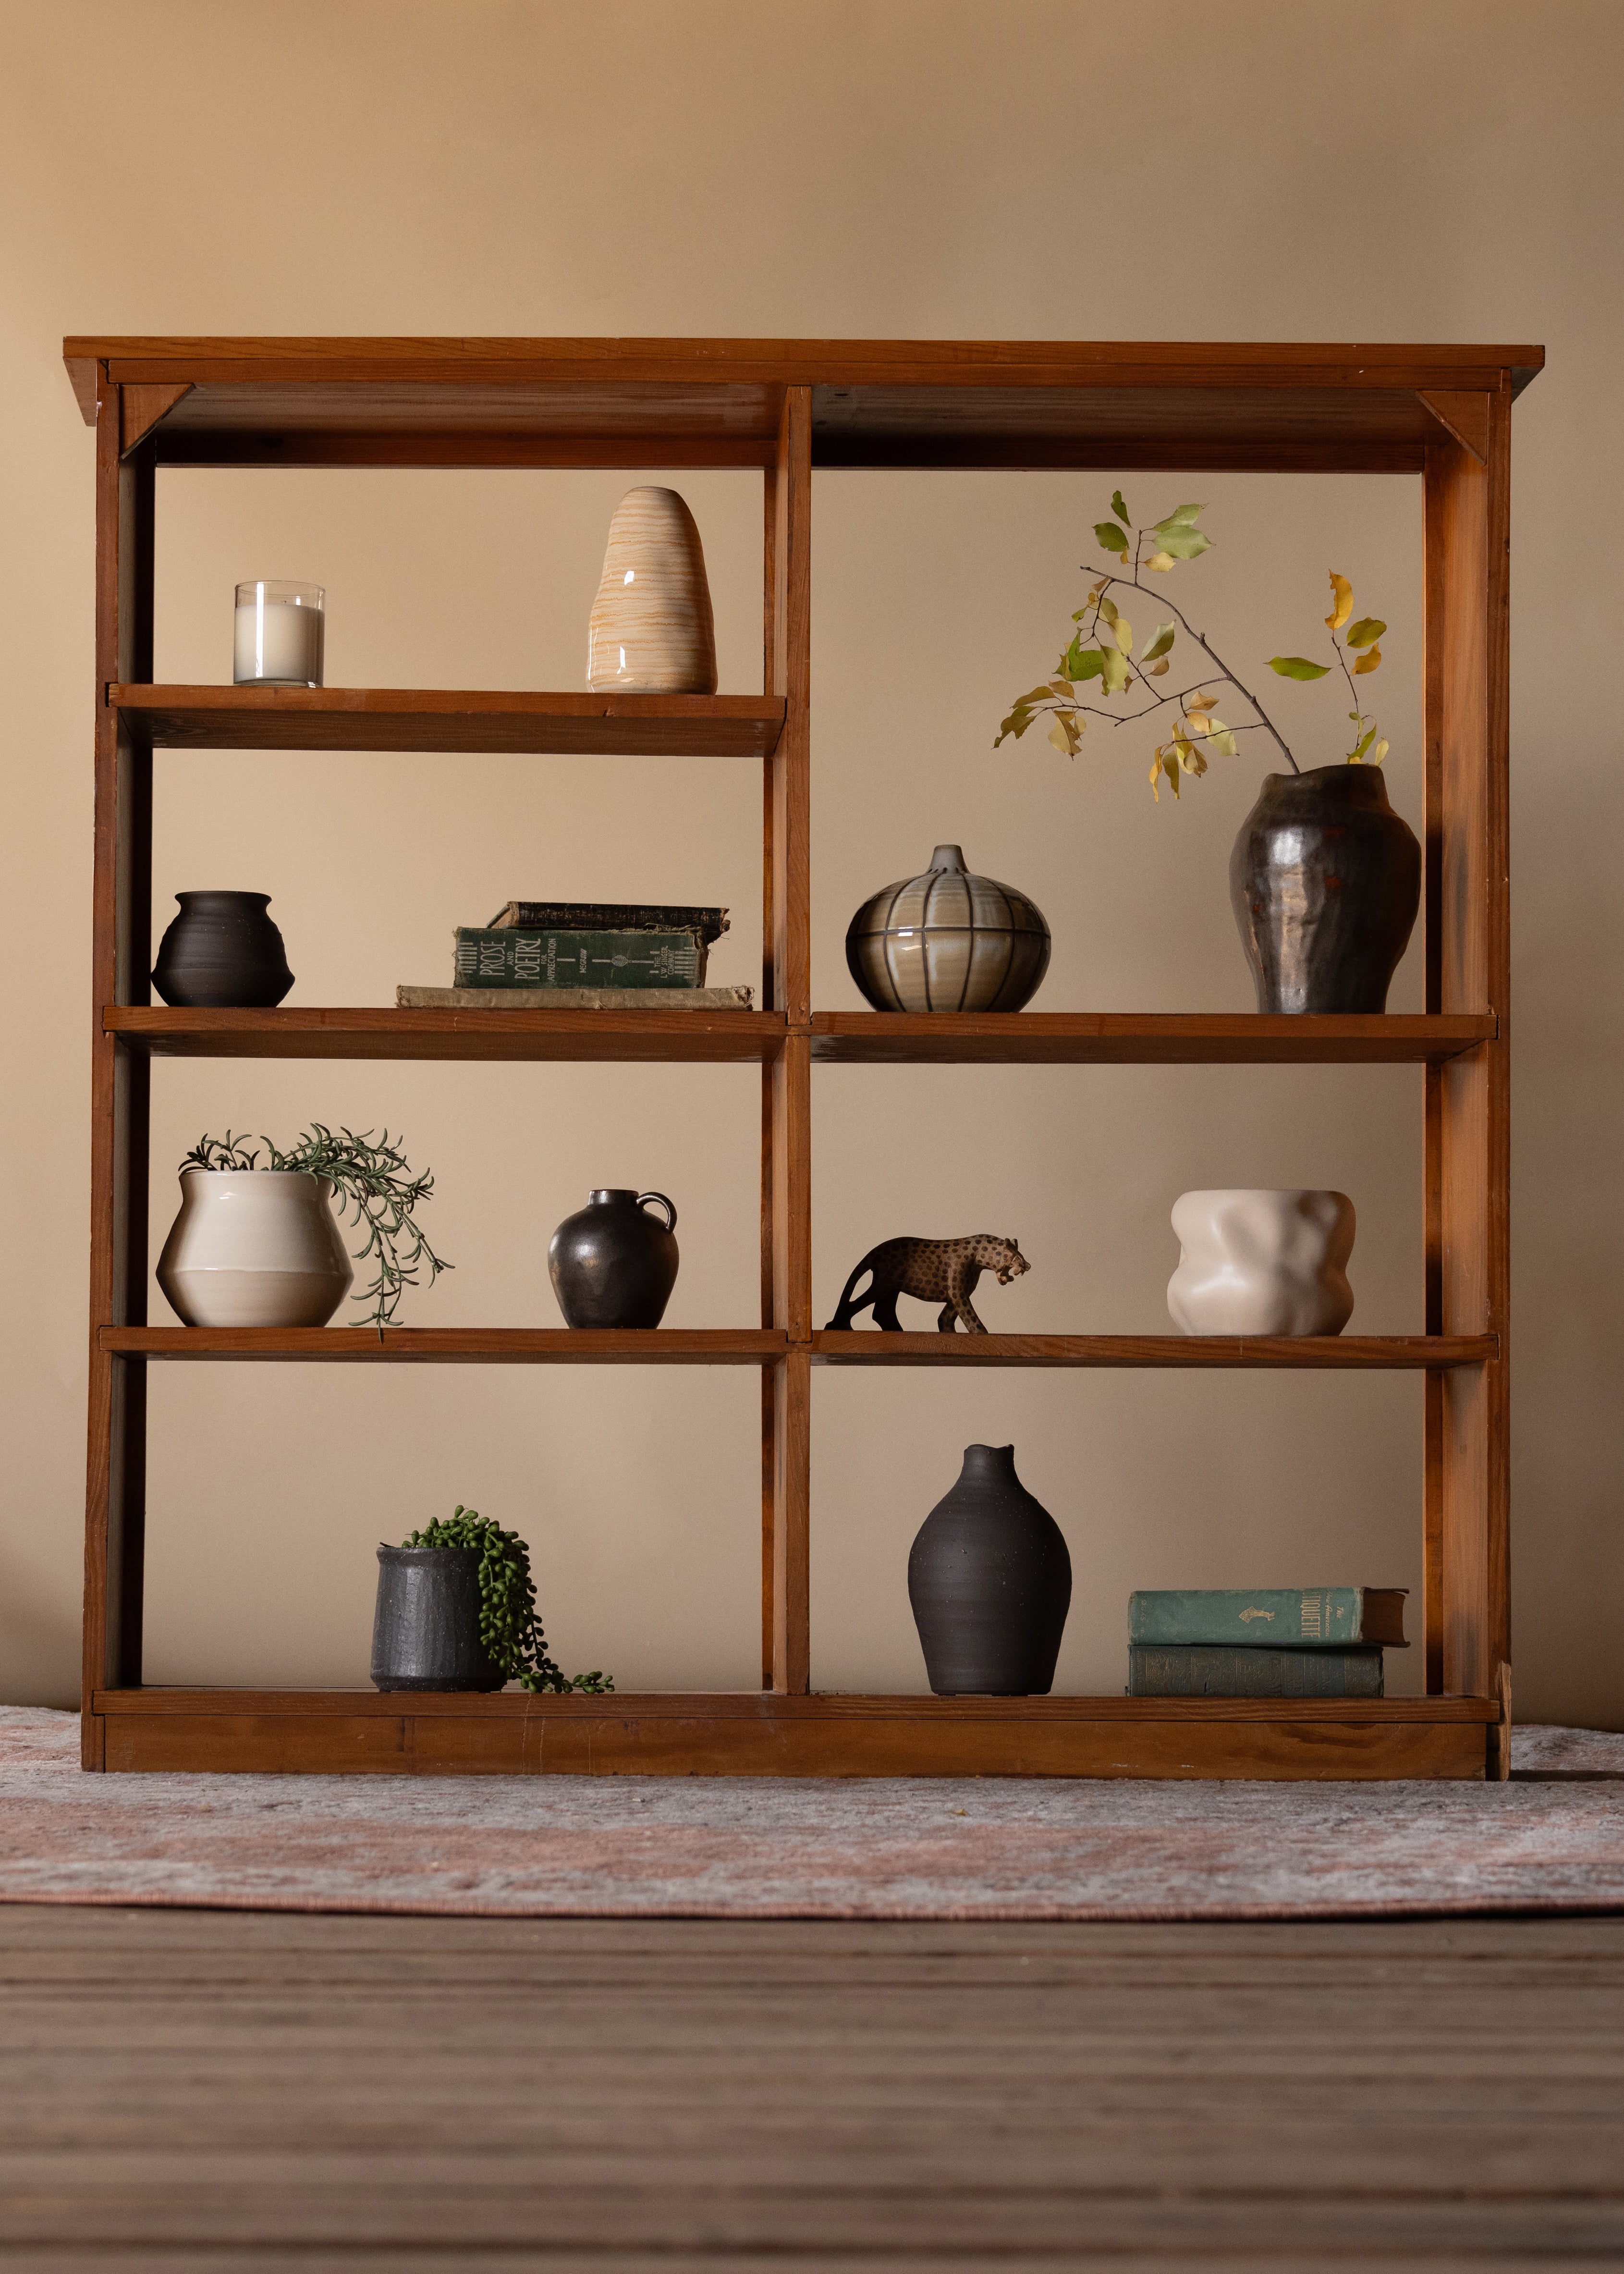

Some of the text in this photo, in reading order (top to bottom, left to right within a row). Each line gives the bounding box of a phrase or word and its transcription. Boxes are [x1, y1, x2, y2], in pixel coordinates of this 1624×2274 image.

[480, 941, 506, 976] PROSE
[514, 938, 541, 980] POETRY
[548, 938, 556, 981] APPRECIATION
[1300, 1591, 1321, 1638] TIQUETTE
